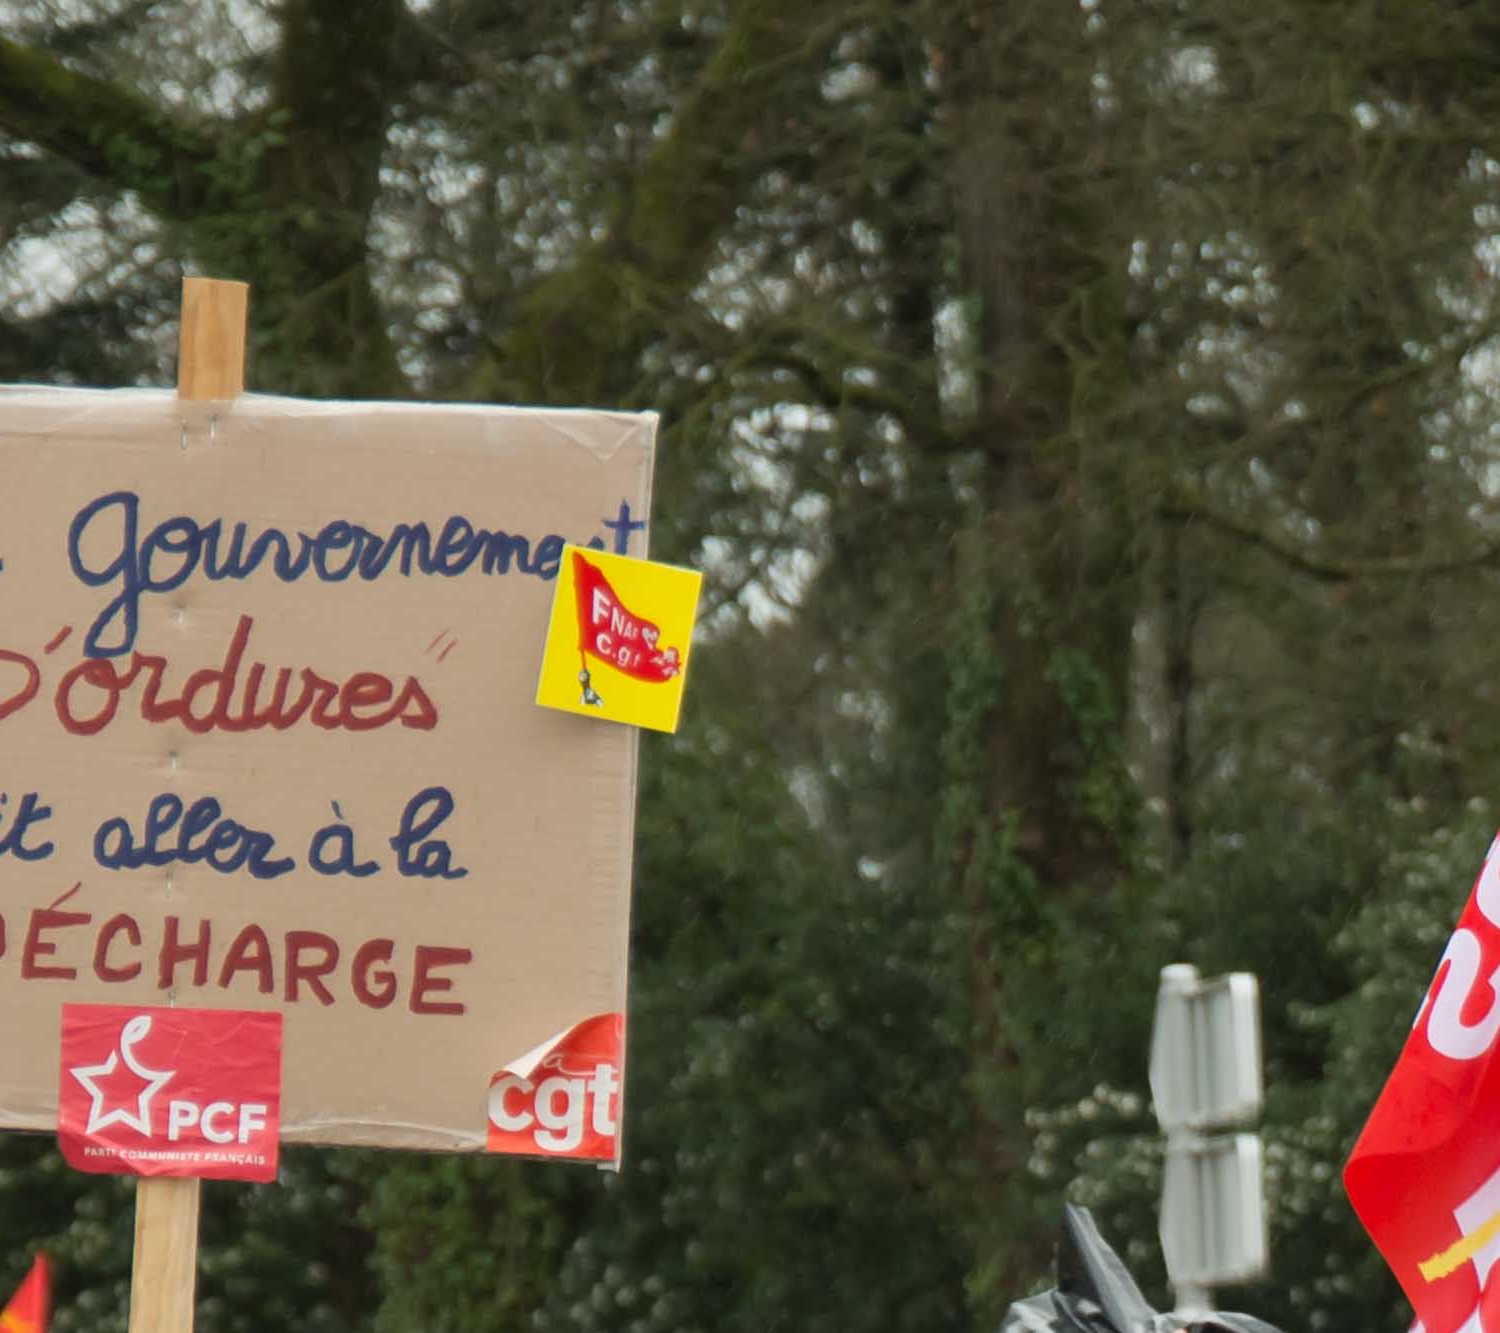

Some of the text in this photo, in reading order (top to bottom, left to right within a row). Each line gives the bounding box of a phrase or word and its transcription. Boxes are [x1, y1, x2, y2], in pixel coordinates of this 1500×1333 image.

[68, 490, 646, 660] gouvernemet
[309, 800, 380, 880] à
[389, 784, 469, 881] la
[168, 1101, 268, 1145] PCF
[488, 1064, 618, 1152] cgt
[117, 1149, 200, 1162] COMMUNISTE
[204, 1152, 266, 1167] FRANÇAIS
